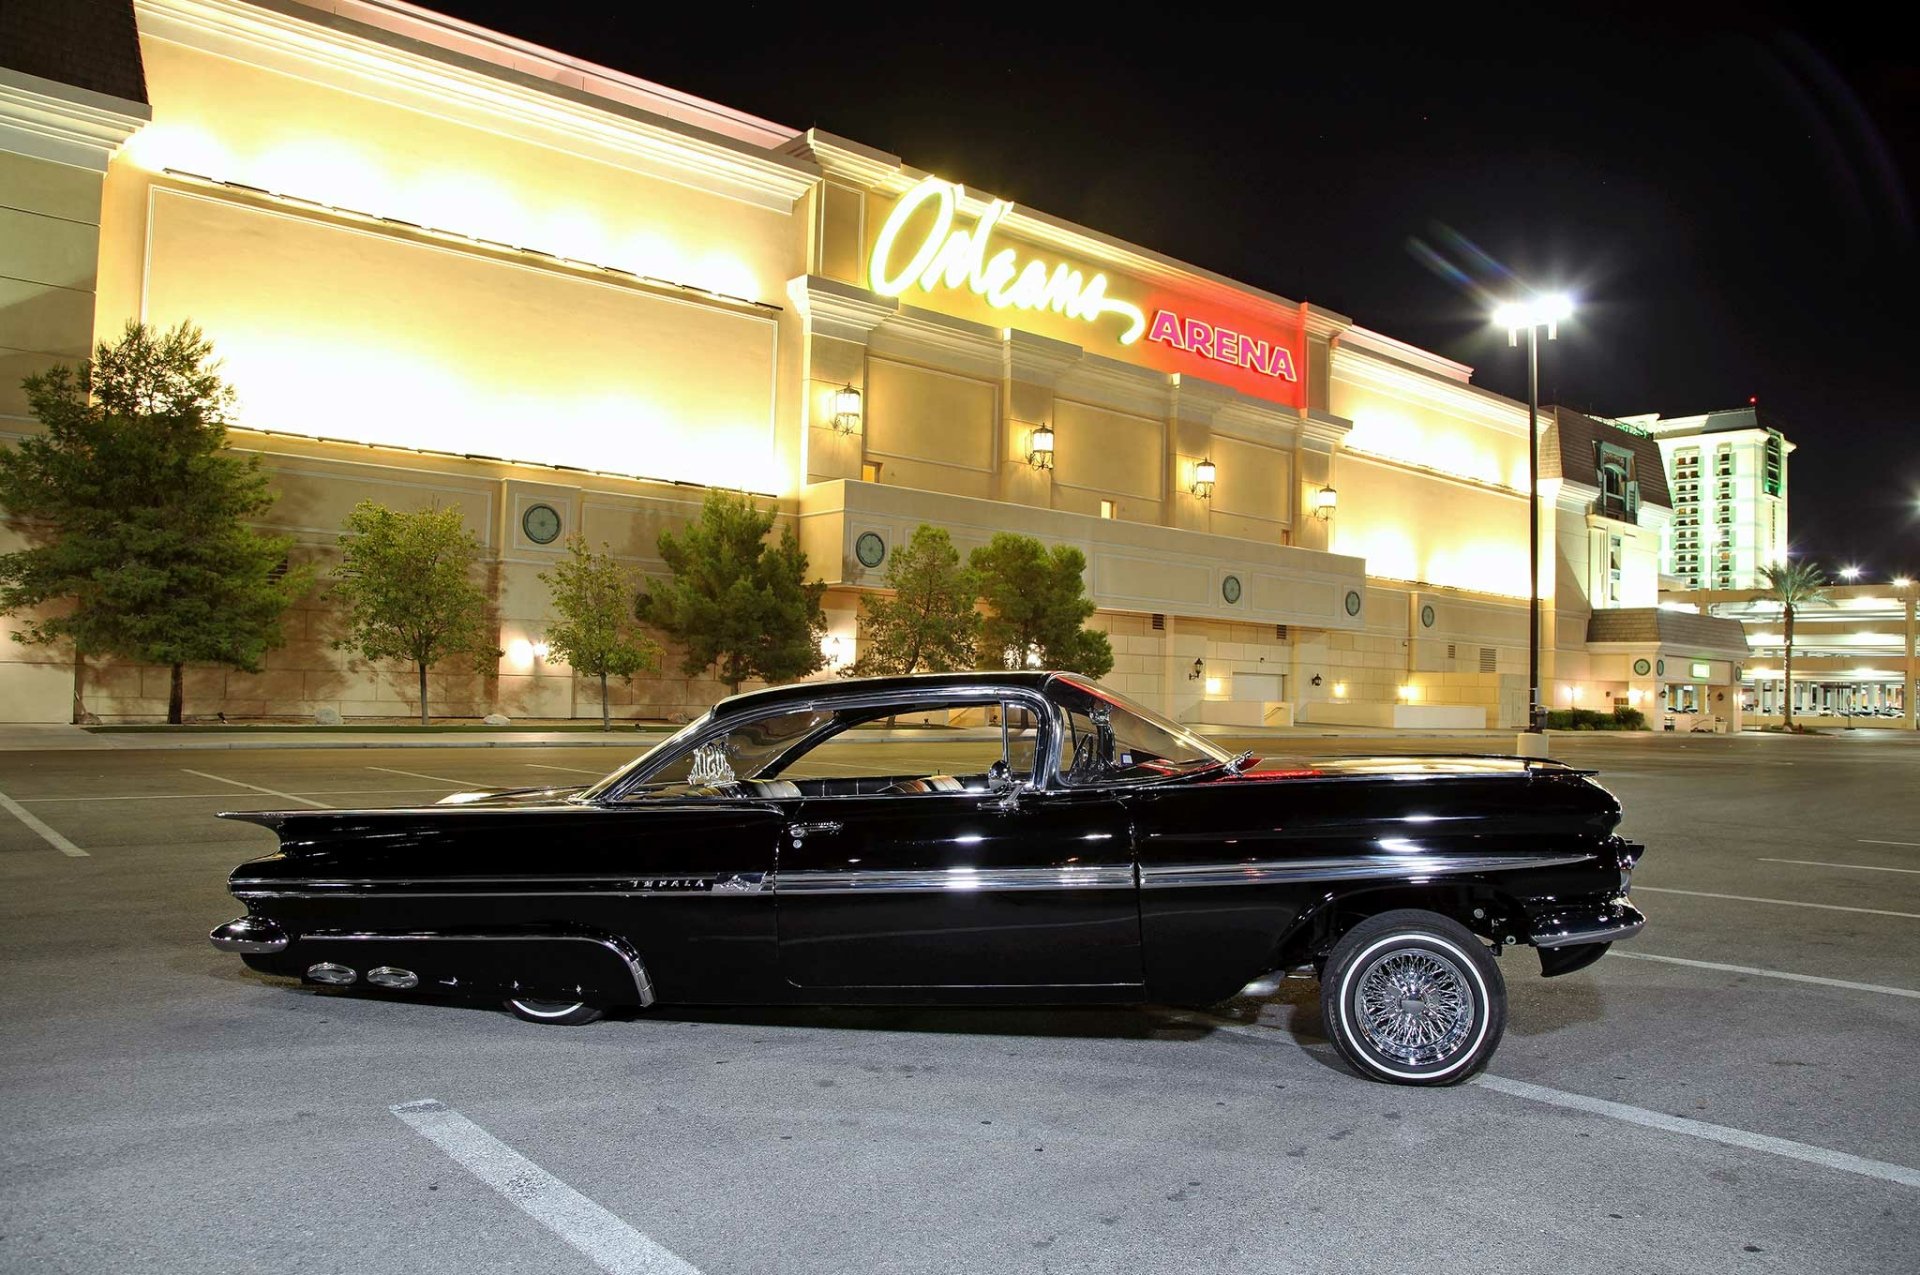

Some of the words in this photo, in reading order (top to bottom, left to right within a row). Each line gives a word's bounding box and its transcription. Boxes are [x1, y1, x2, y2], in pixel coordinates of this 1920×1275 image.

[869, 175, 1146, 345] Orleans
[1149, 309, 1297, 382] ARENA
[632, 879, 704, 887] IMPALA
